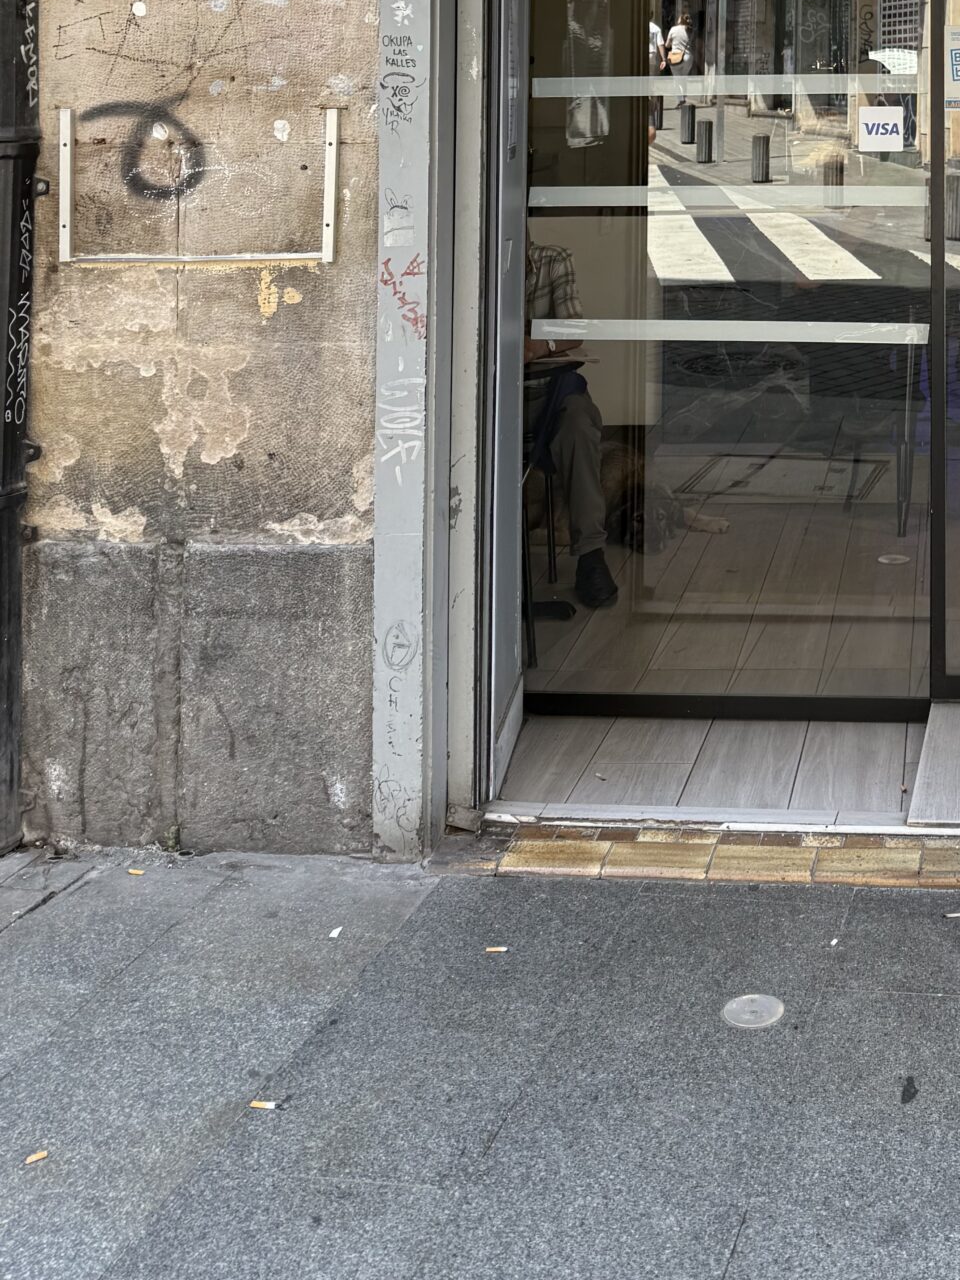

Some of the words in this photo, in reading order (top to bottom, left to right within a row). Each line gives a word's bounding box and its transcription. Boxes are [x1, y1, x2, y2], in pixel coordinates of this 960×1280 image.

[382, 35, 412, 47] OKUPA
[386, 56, 416, 68] KALLES
[862, 123, 899, 135] VISA
